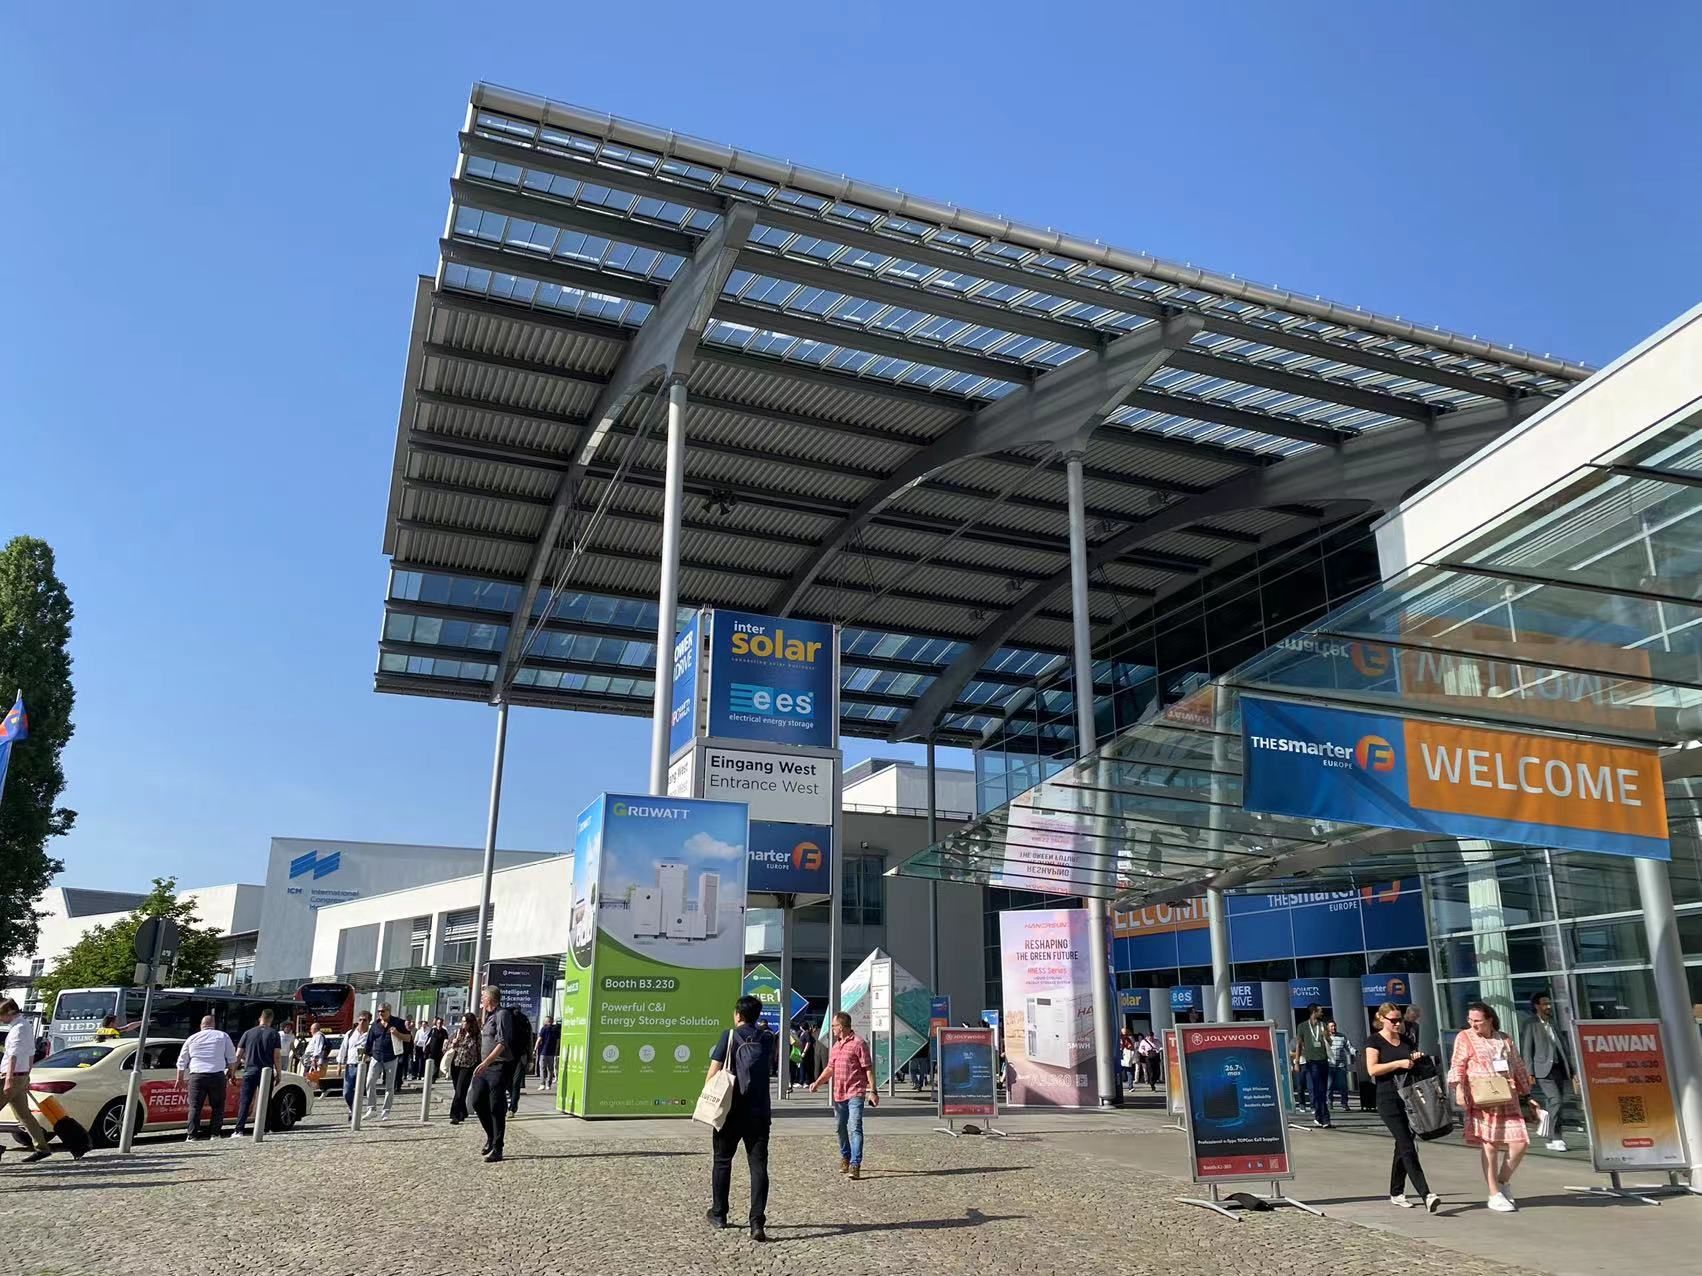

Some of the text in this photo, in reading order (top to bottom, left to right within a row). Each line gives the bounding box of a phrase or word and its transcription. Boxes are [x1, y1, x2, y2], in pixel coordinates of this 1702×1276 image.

[734, 620, 765, 634] inter
[731, 629, 822, 662] solar
[753, 690, 812, 714] ees
[729, 713, 814, 730] electrical energy storage
[711, 755, 817, 776] Eingang West
[1323, 759, 1353, 770] EUROPE
[1420, 743, 1642, 806] WELCOME
[710, 774, 819, 795] Entrance West
[613, 802, 691, 819] GROWATT
[766, 863, 790, 871] EUROPE
[1329, 900, 1358, 912] EUROPE
[1024, 939, 1068, 950] RESHAPING
[1016, 951, 1079, 960] THE GREEN FUTURE
[605, 978, 675, 989] Booth B3.230
[1172, 992, 1190, 1001] ees
[1231, 986, 1252, 996] WER
[1231, 996, 1253, 1006] RIVE
[601, 1002, 666, 1012] Powerful C&I
[600, 1016, 636, 1028] Energy
[638, 1016, 677, 1028] Storage
[679, 1016, 720, 1026] Solution
[1204, 1034, 1260, 1042] JOLYWOOD
[1583, 1034, 1657, 1053] TAIWAN
[149, 1095, 189, 1106] FREEN
